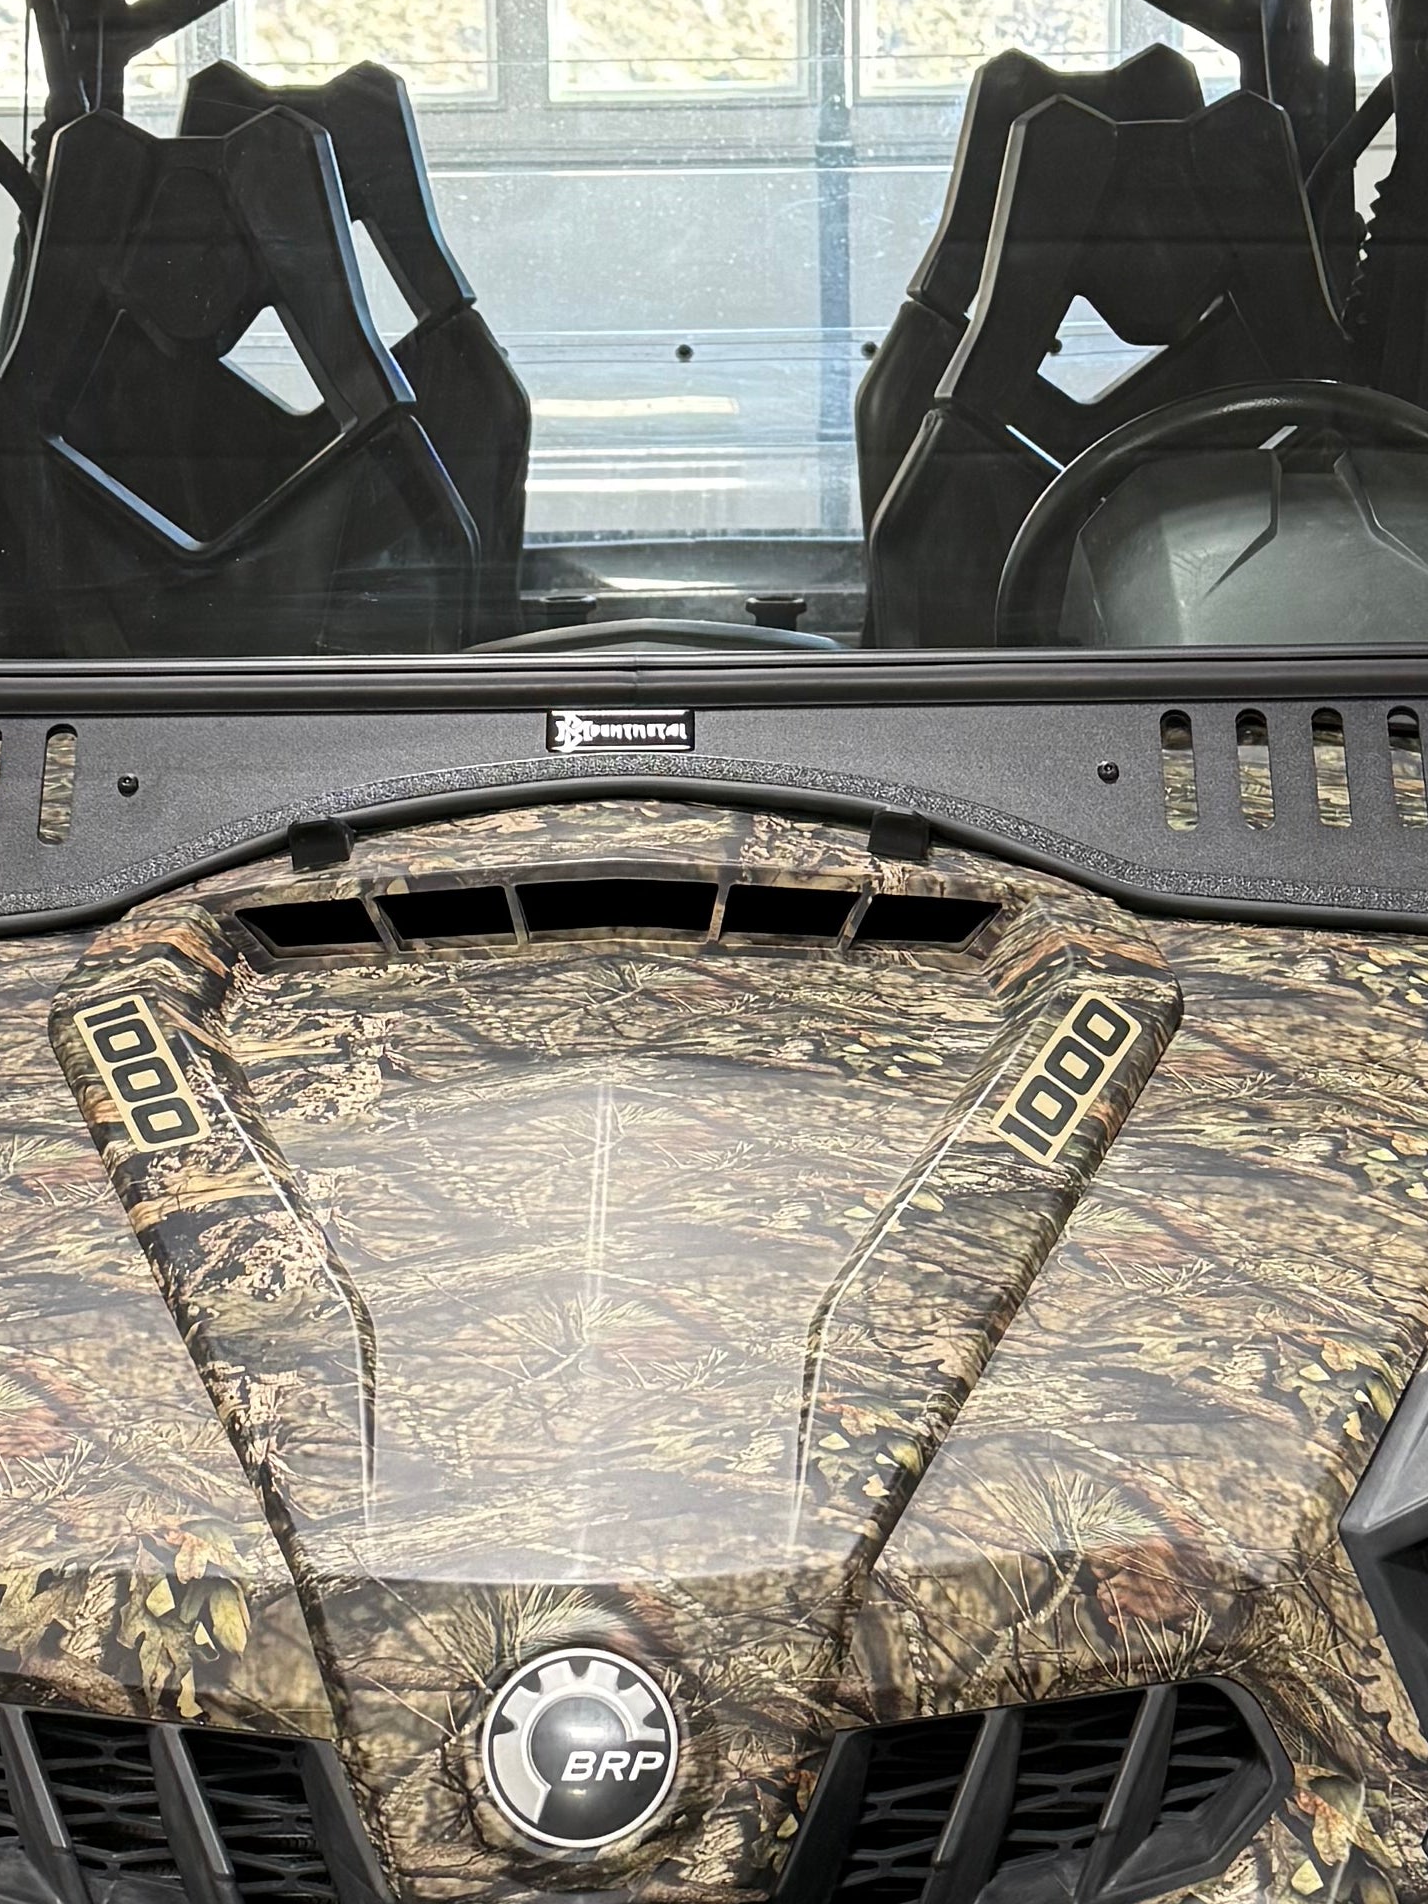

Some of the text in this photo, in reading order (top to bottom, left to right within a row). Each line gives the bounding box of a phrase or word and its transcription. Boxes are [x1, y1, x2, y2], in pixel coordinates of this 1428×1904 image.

[83, 1000, 200, 1145] 1000
[998, 998, 1131, 1157] 1000
[560, 1750, 666, 1782] BRP
